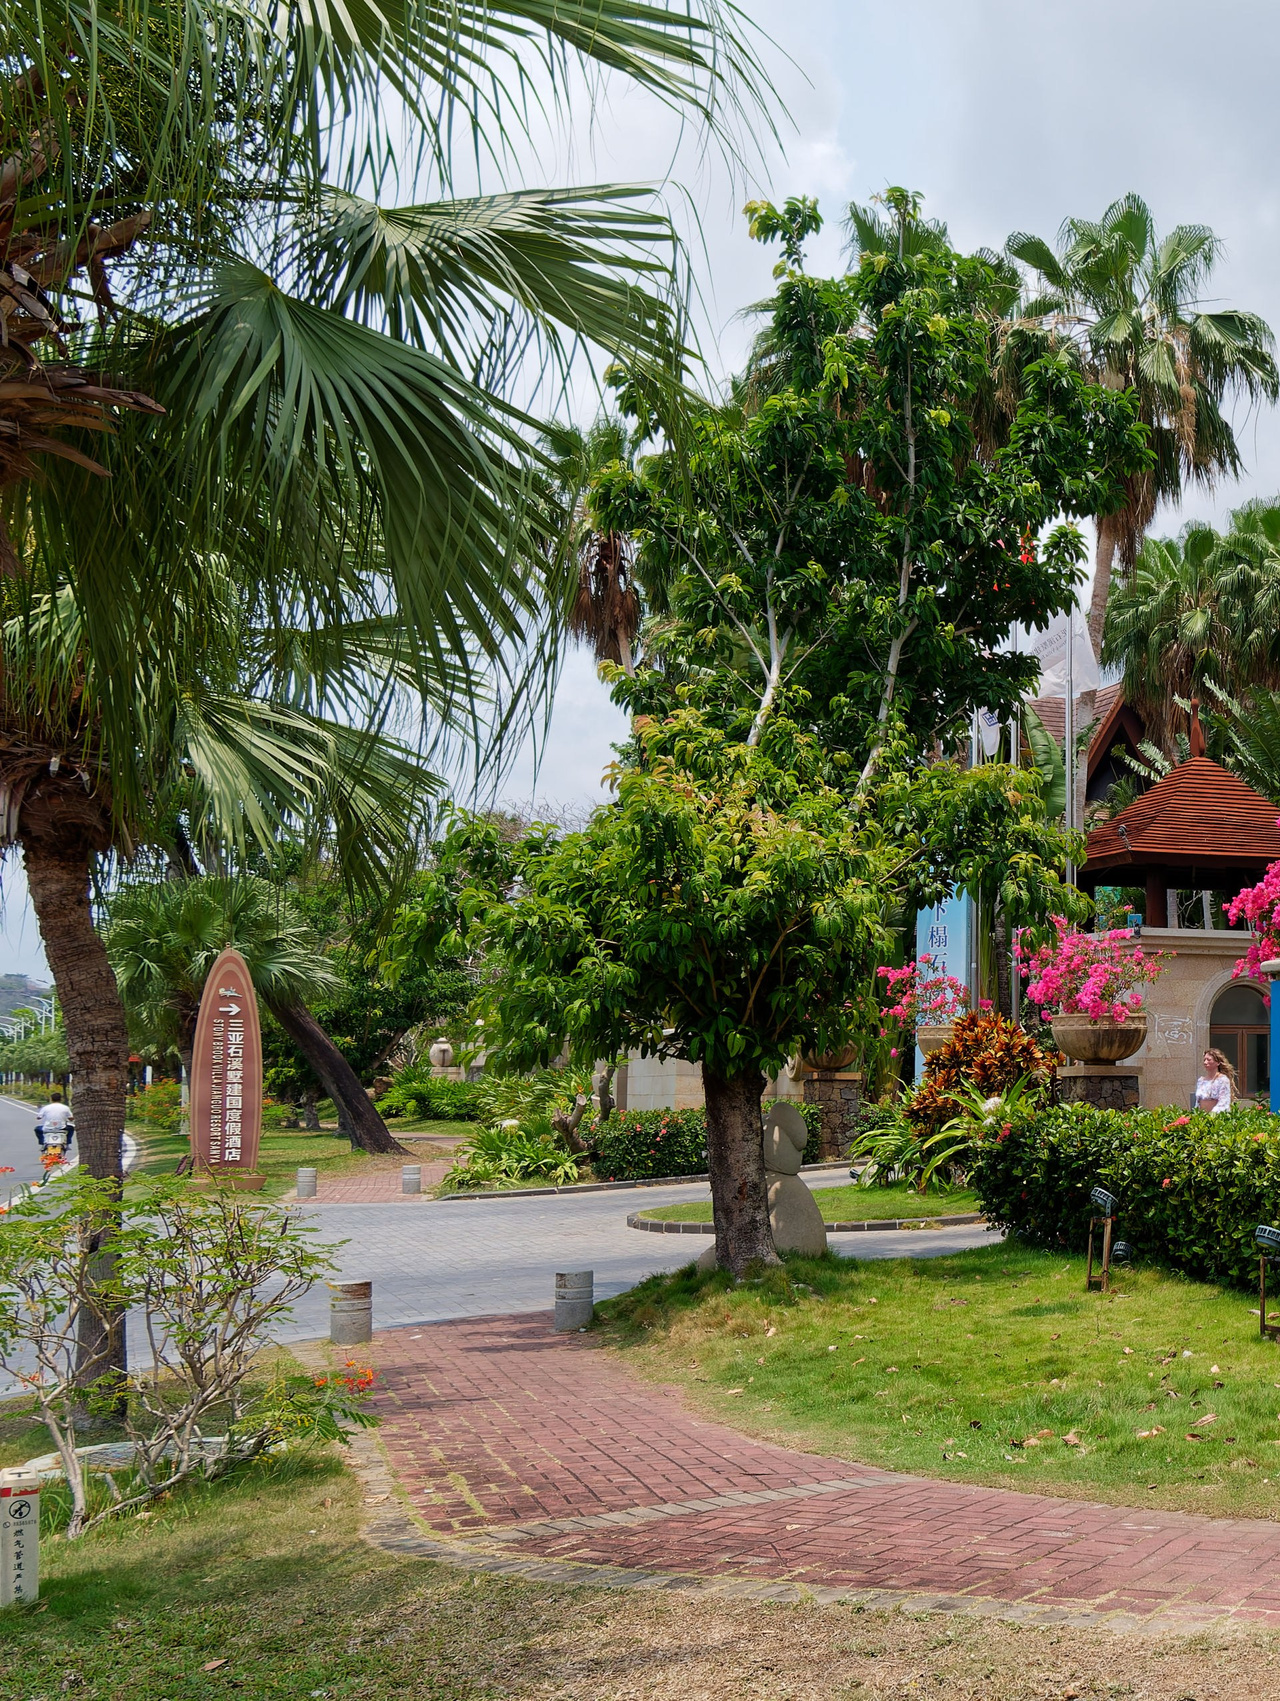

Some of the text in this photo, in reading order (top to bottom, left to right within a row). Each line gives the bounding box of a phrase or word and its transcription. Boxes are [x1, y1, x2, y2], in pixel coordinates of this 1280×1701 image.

[209, 1019, 224, 1163] STONY BROOK VILLA JIANGUO RESORT SANYA
[224, 1019, 245, 1161] 三亚石溪墅建国度假酒店
